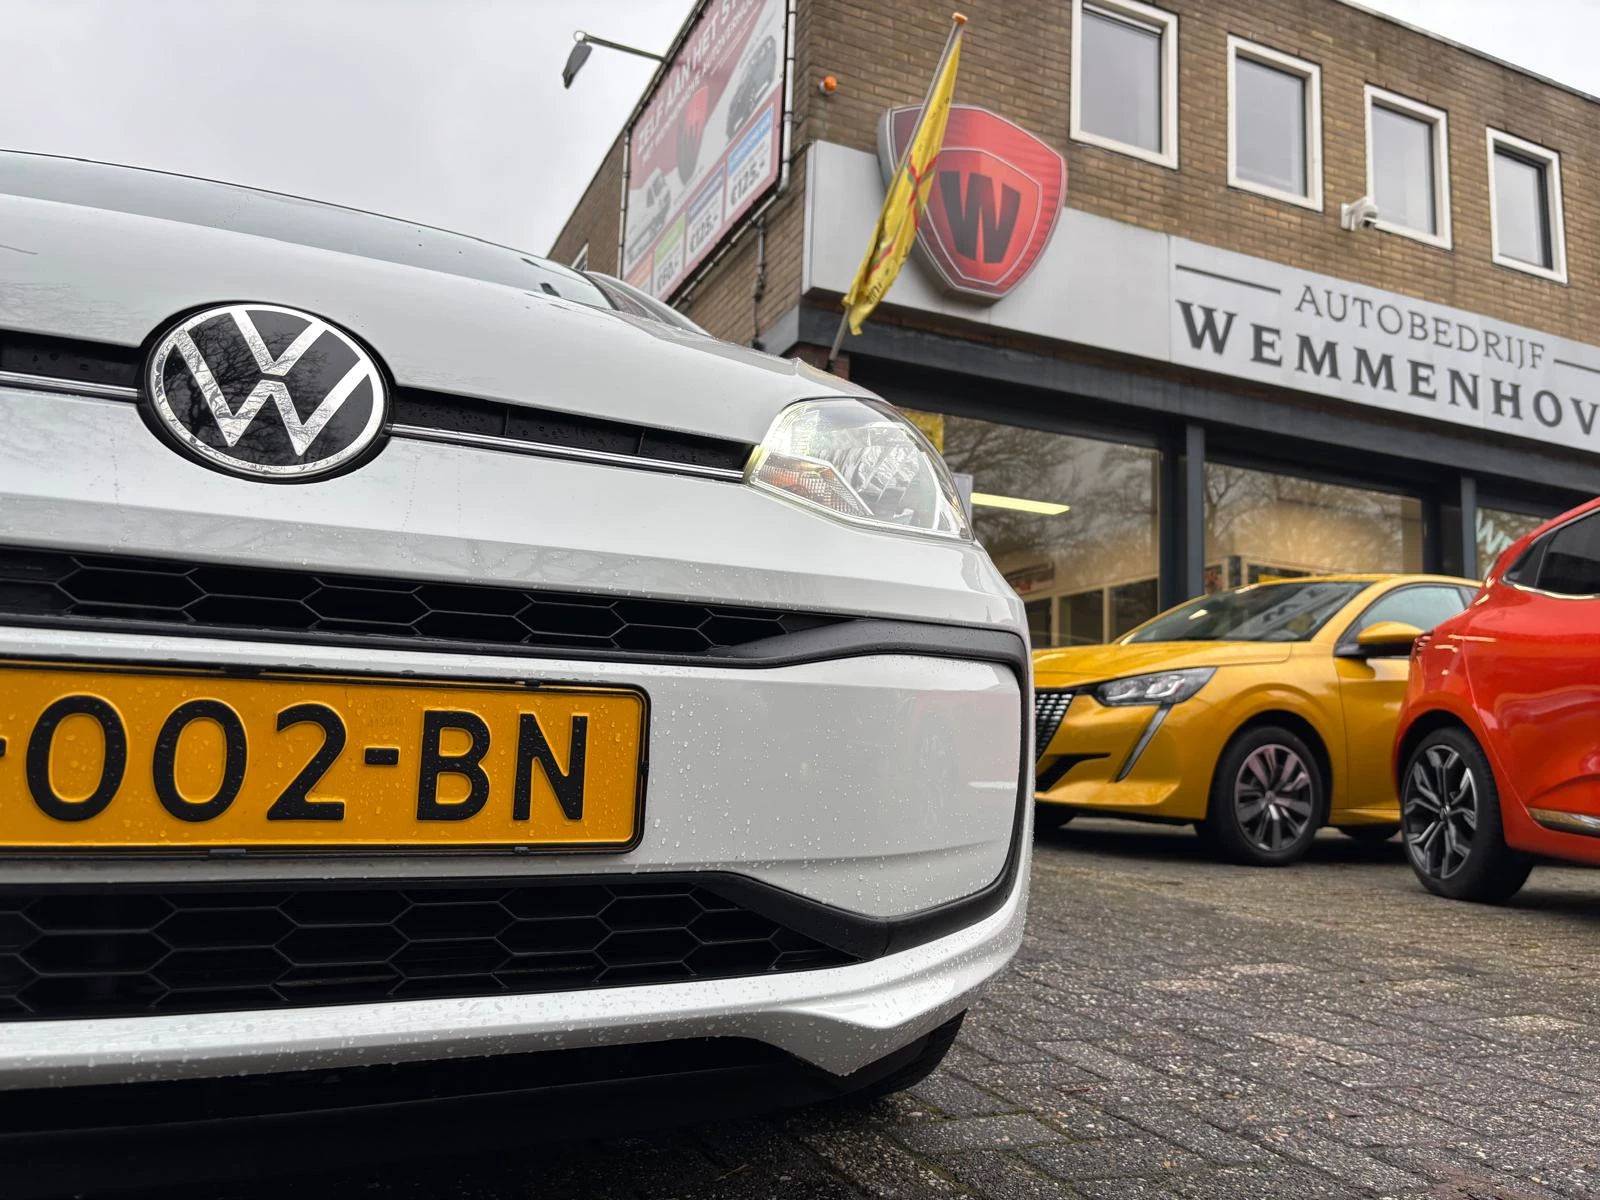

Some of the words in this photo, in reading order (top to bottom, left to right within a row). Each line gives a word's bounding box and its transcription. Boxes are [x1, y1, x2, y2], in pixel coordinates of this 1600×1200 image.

[664, 56, 691, 116] AAN
[692, 10, 720, 71] HET
[939, 171, 1021, 264] W
[1176, 299, 1599, 436] WEMMENHOV
[1295, 285, 1545, 370] AUTOBEDRIJF
[0, 693, 589, 822] 002-BN
